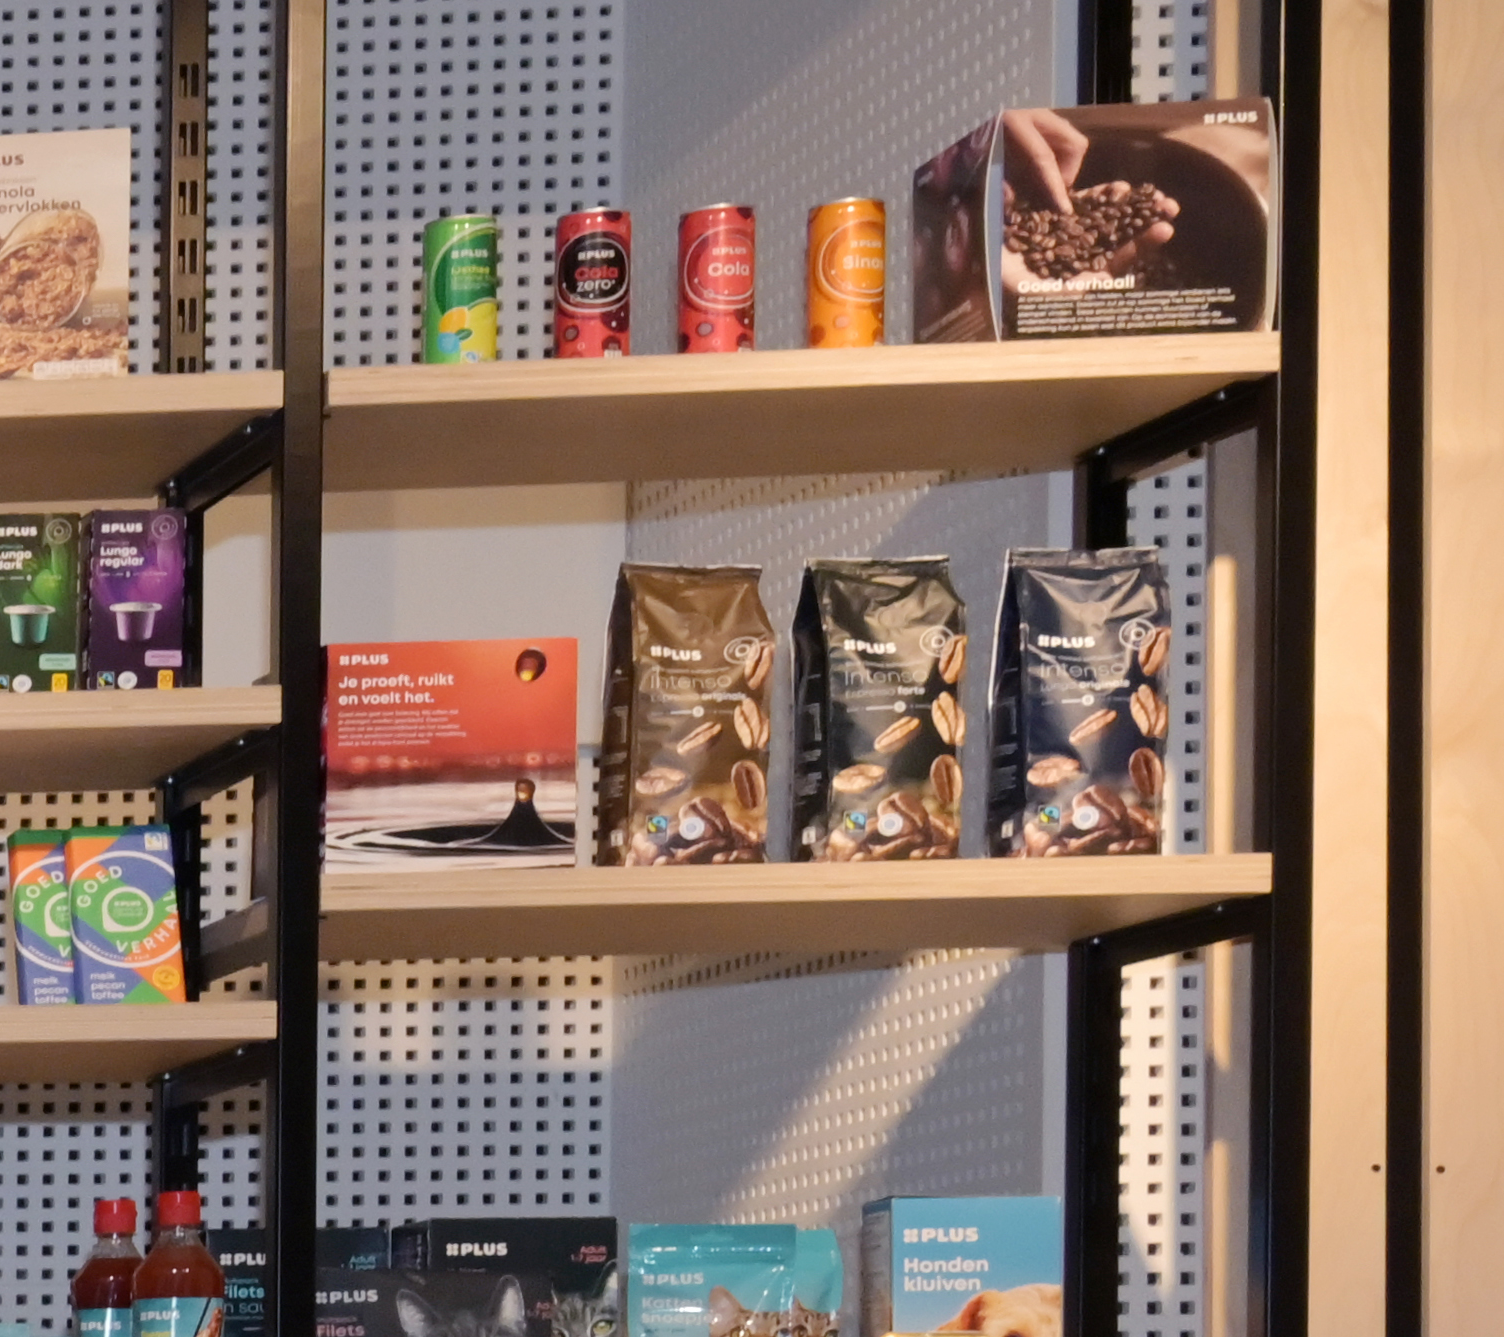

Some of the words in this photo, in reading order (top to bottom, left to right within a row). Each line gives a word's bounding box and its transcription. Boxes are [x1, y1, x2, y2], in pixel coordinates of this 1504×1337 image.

[1216, 110, 1258, 124] PLUS
[575, 265, 618, 279] Cola
[708, 263, 750, 277] Cola
[1017, 278, 1063, 294] Goed
[1066, 274, 1136, 291] verhaal!
[100, 545, 137, 558] Lungo
[100, 556, 145, 568] regular
[857, 642, 897, 655] PLUS
[1050, 636, 1096, 648] PLUS
[351, 654, 389, 666] PLUS
[844, 670, 927, 684] Intenso
[1040, 663, 1125, 678] Intenso
[339, 676, 358, 688] Je
[361, 673, 414, 690] proeft,
[418, 673, 454, 686] ruikt
[650, 674, 732, 690] Intenso
[897, 686, 925, 696] forte
[338, 694, 358, 706] en
[361, 691, 401, 704] voelt
[404, 691, 434, 703] het.
[19, 869, 65, 913] GOED
[76, 865, 122, 907] GOED
[115, 886, 178, 954] VERHAAL
[922, 1227, 979, 1243] PLUS
[460, 1242, 508, 1256] PLUS
[234, 1252, 266, 1265] PLU
[904, 1256, 989, 1273] Honden
[657, 1272, 704, 1285] PLUS
[904, 1275, 981, 1291] kluiven
[330, 1290, 379, 1304] PLUS
[642, 1298, 702, 1308] Katten
[316, 1323, 365, 1337] Filets
